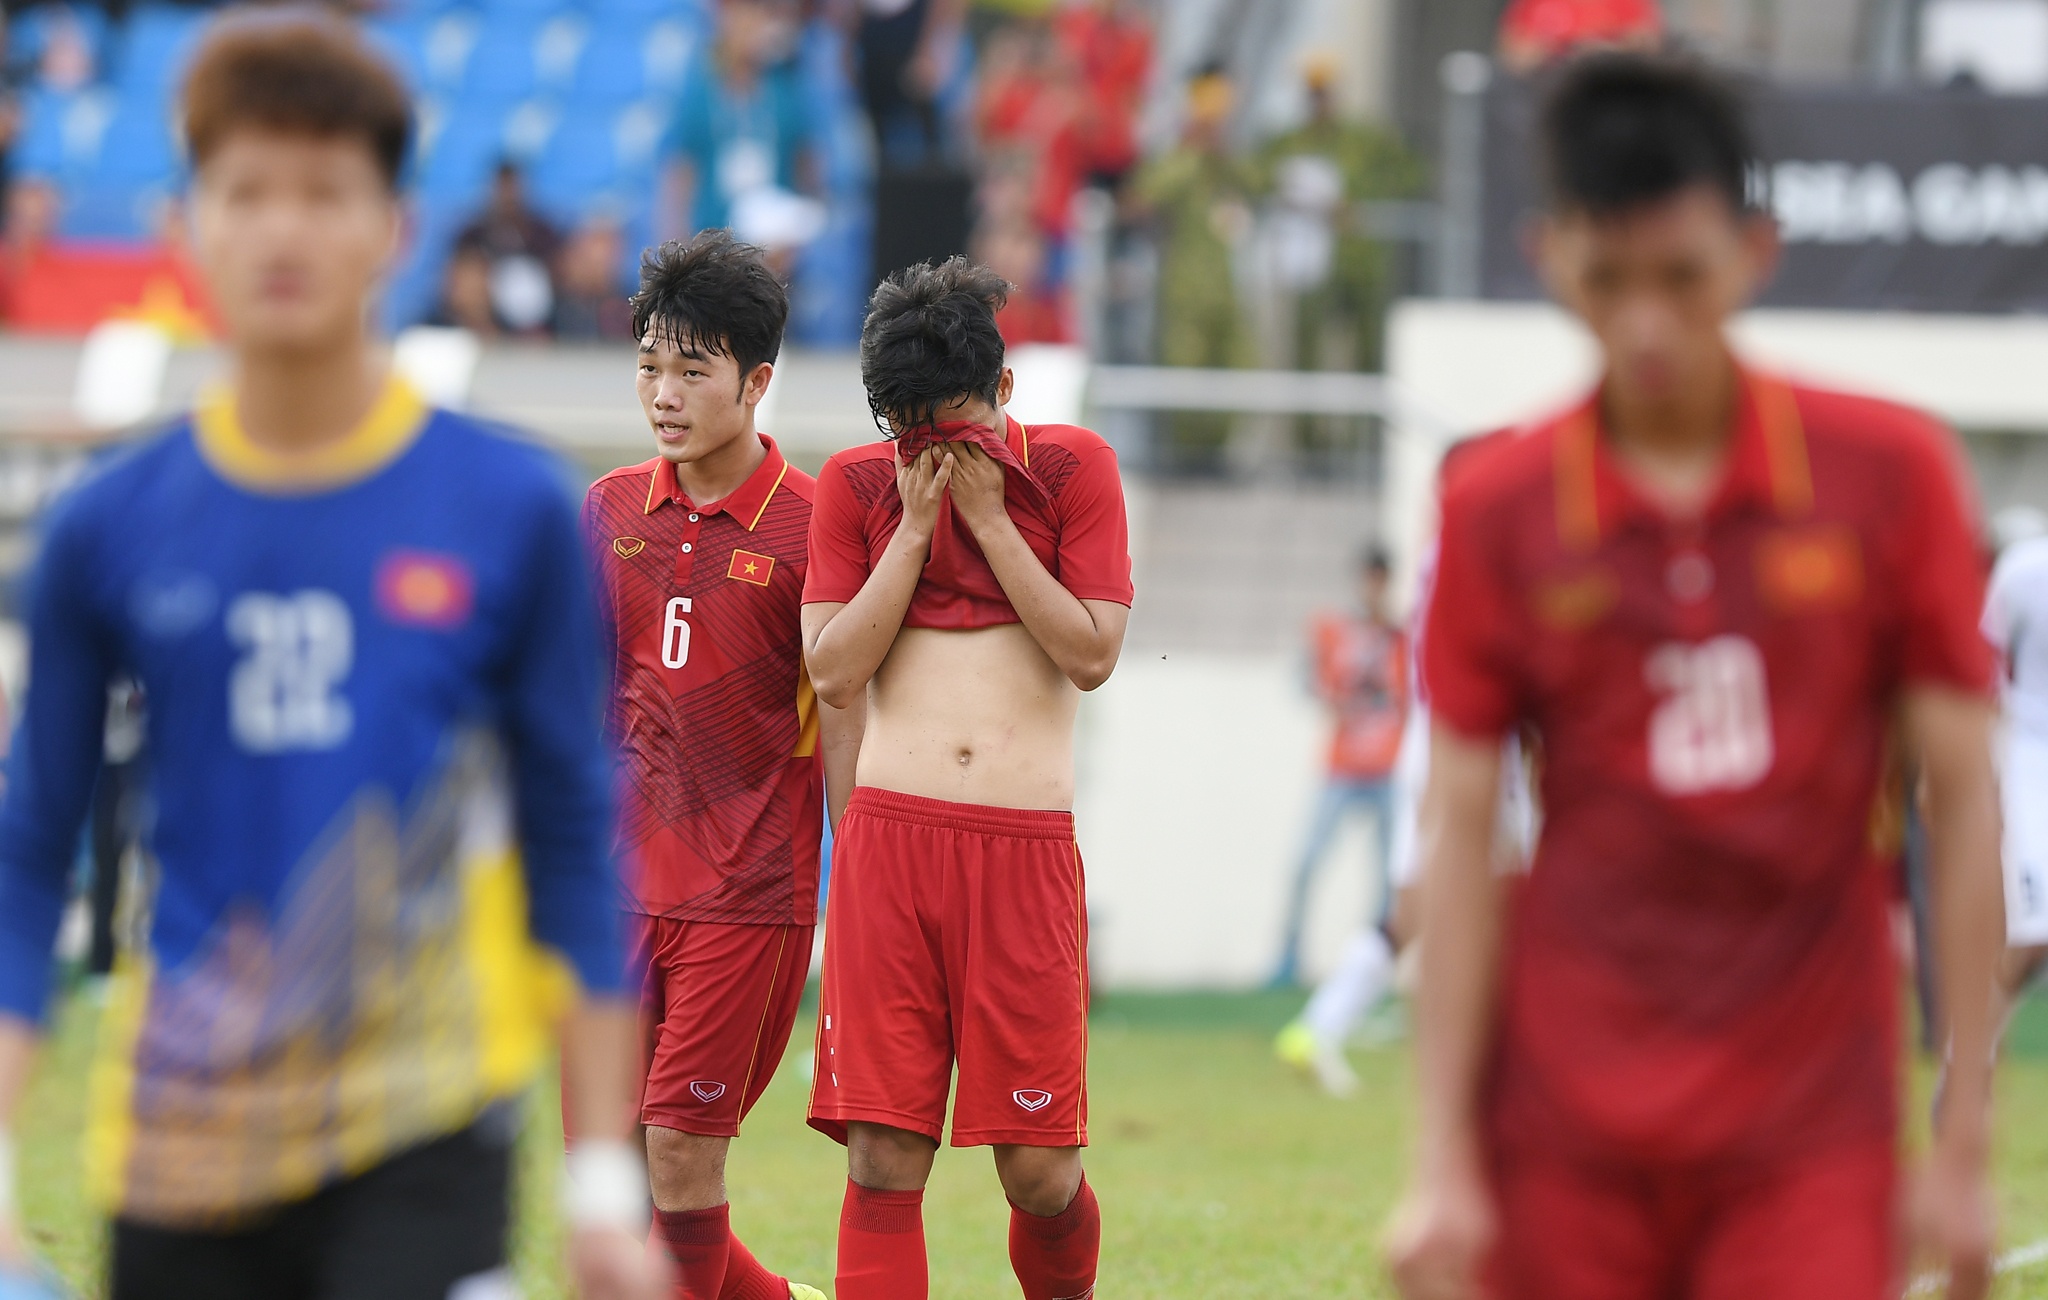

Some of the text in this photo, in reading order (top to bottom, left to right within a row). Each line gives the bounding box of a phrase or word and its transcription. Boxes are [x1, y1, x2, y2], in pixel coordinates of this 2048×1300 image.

[226, 591, 354, 753] 22
[661, 596, 692, 669] 6
[1646, 635, 1775, 793] 20
